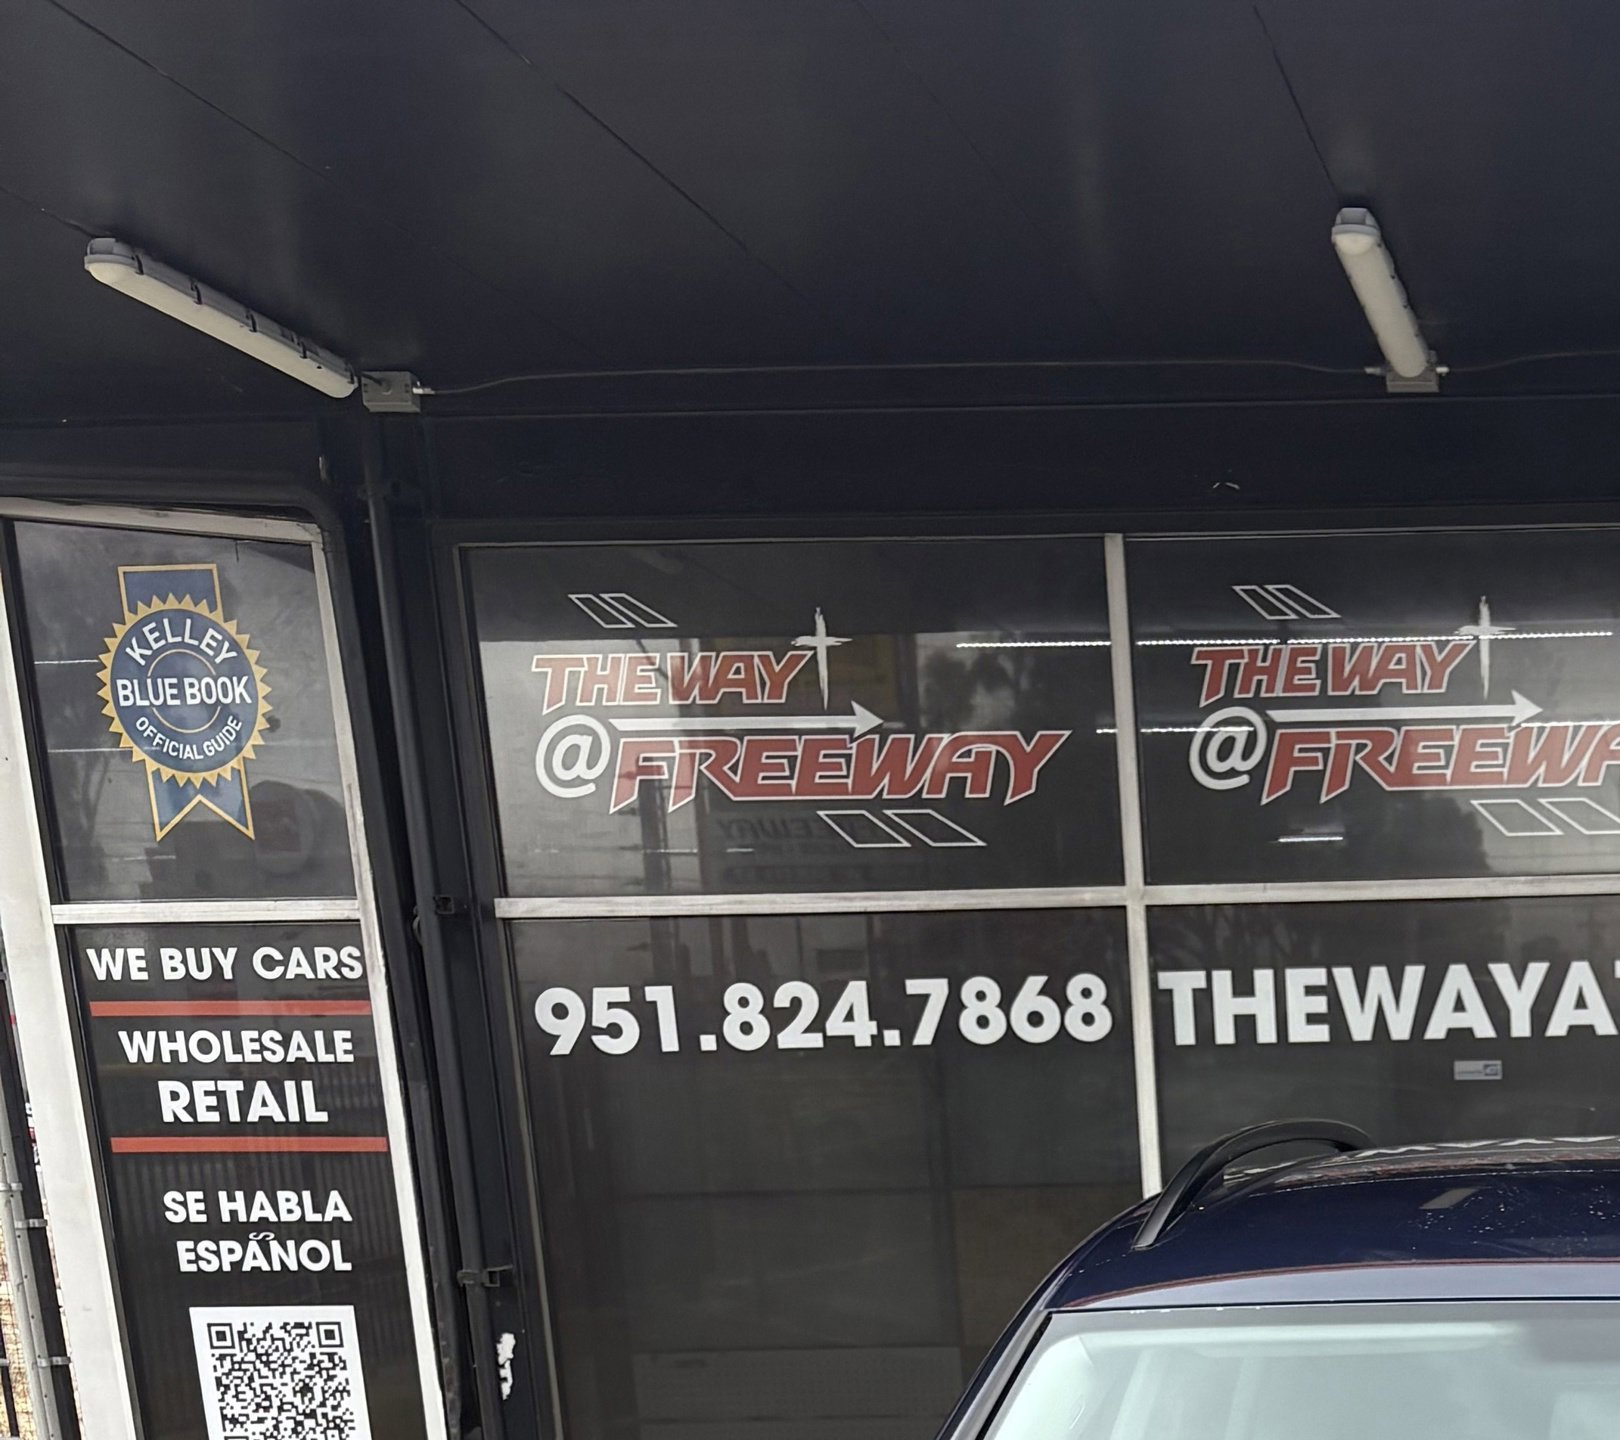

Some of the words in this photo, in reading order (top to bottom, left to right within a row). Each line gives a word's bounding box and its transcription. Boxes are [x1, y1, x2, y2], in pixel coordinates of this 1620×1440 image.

[126, 618, 238, 666] KELLEY
[116, 678, 182, 707] BLUE
[184, 676, 253, 705] BOOK
[136, 717, 204, 760] OFFICIAL
[203, 716, 243, 757] GUIDE
[86, 947, 149, 981] WE
[159, 947, 238, 981] BUY
[252, 946, 363, 980] CARS
[534, 973, 1113, 1056] 951.824.7868
[117, 1029, 355, 1063] WHOLESALE
[158, 1080, 329, 1123] RETAIL
[163, 1190, 208, 1223] SE
[217, 1190, 353, 1222] HABLA
